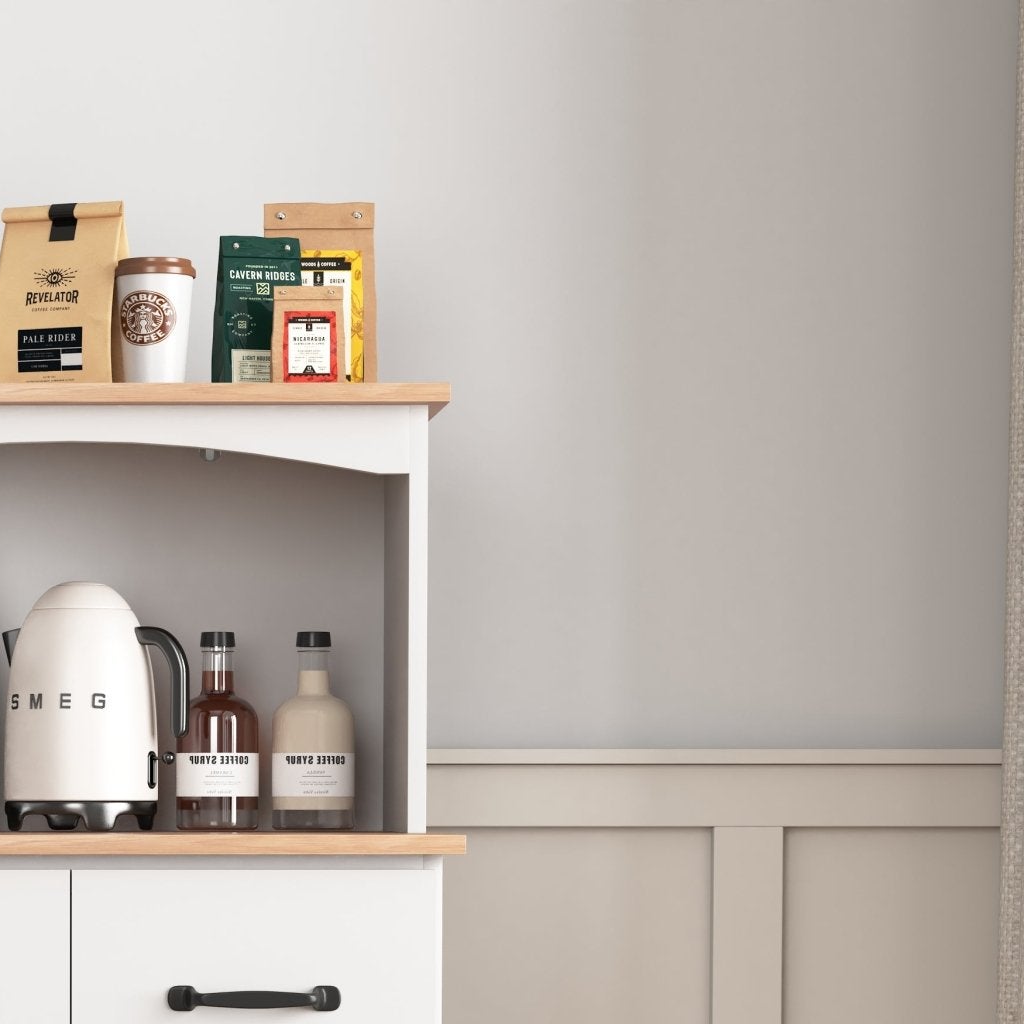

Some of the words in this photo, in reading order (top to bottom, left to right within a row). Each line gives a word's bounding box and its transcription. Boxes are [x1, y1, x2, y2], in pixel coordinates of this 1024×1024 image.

[229, 269, 263, 280] CAVERN
[265, 271, 296, 281] RIDGES
[25, 289, 79, 306] REVELATOR
[121, 293, 173, 318] STARBUCKS
[22, 334, 45, 344] PALE
[48, 333, 77, 342] RIDER
[125, 329, 166, 343] COFFEE
[11, 692, 106, 710] SMEG
